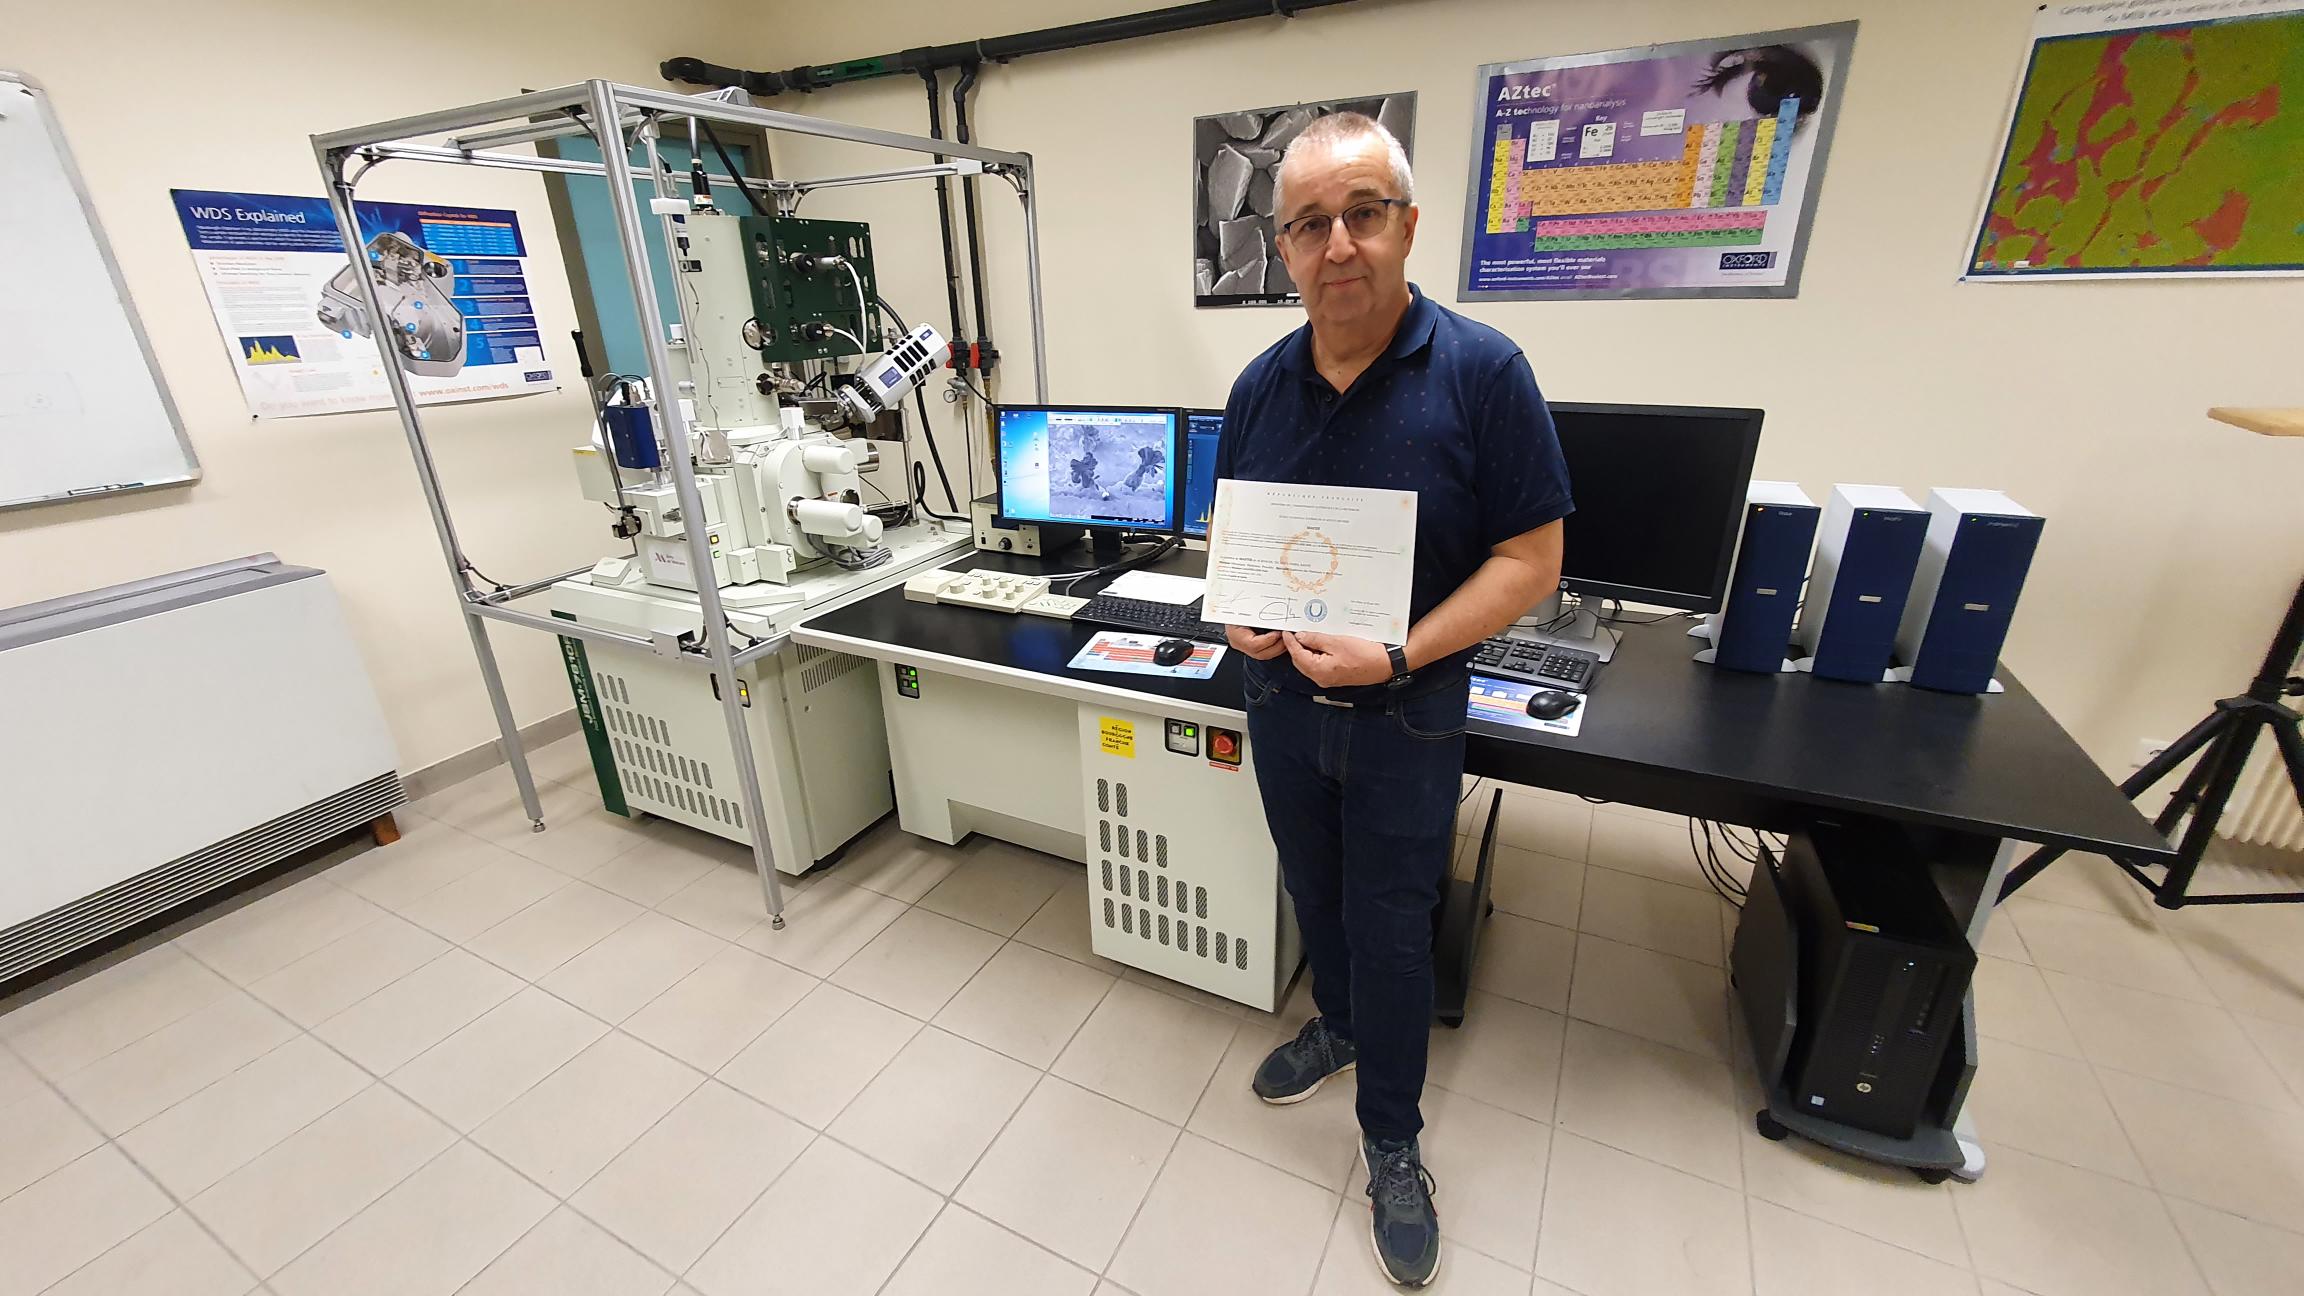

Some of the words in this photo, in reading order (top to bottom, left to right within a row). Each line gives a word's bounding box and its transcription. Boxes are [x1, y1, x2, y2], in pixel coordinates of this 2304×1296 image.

[1497, 84, 1552, 102] AZtec
[1496, 109, 1511, 117] A-Z
[1513, 105, 1559, 117] technology
[1560, 103, 1572, 111] for
[1574, 98, 1626, 110] nanoanalysis
[1585, 126, 1599, 137] Fe
[190, 206, 232, 220] WDS
[235, 208, 306, 224] Explained
[1722, 253, 1768, 265] OXFORD
